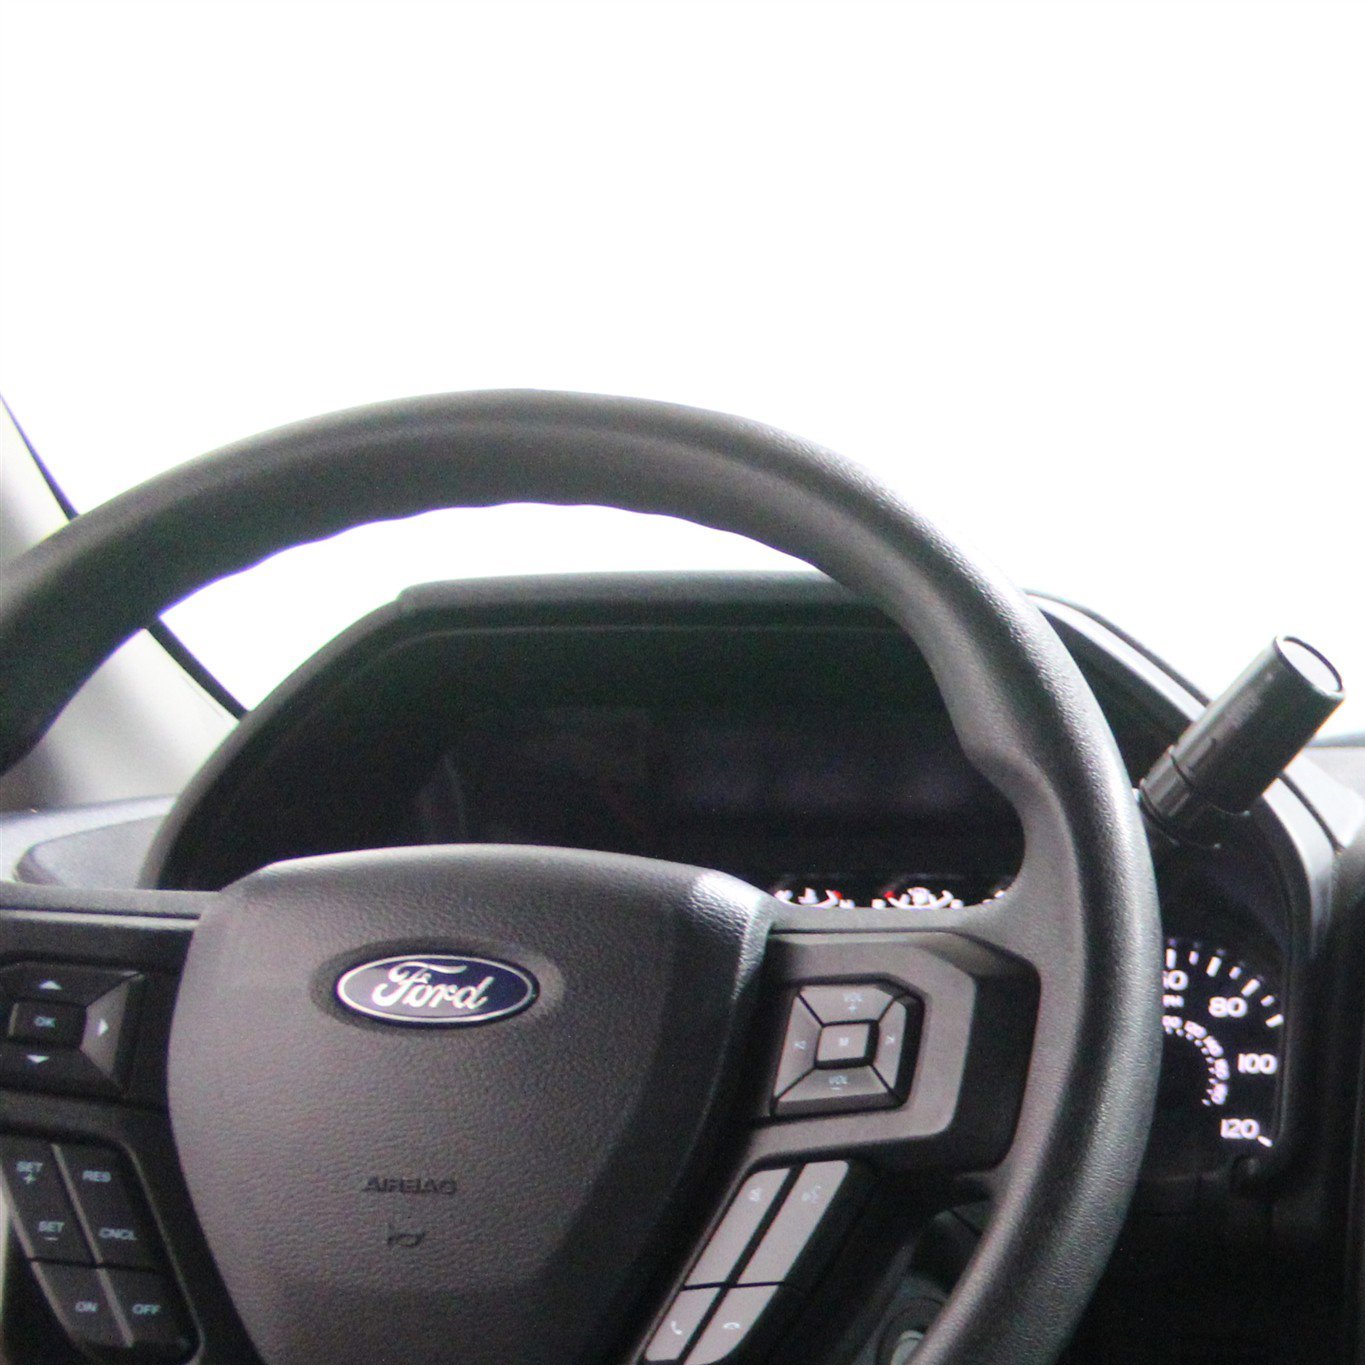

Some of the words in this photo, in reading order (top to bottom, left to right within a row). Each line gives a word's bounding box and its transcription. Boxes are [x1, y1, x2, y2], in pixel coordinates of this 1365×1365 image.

[372, 961, 495, 1010] Ford
[1208, 996, 1248, 1018] 80
[1238, 1053, 1278, 1075] 100
[1220, 1118, 1259, 1139] 120
[38, 1220, 65, 1233] SET
[74, 1301, 100, 1313] ON
[131, 1303, 161, 1315] OFF
